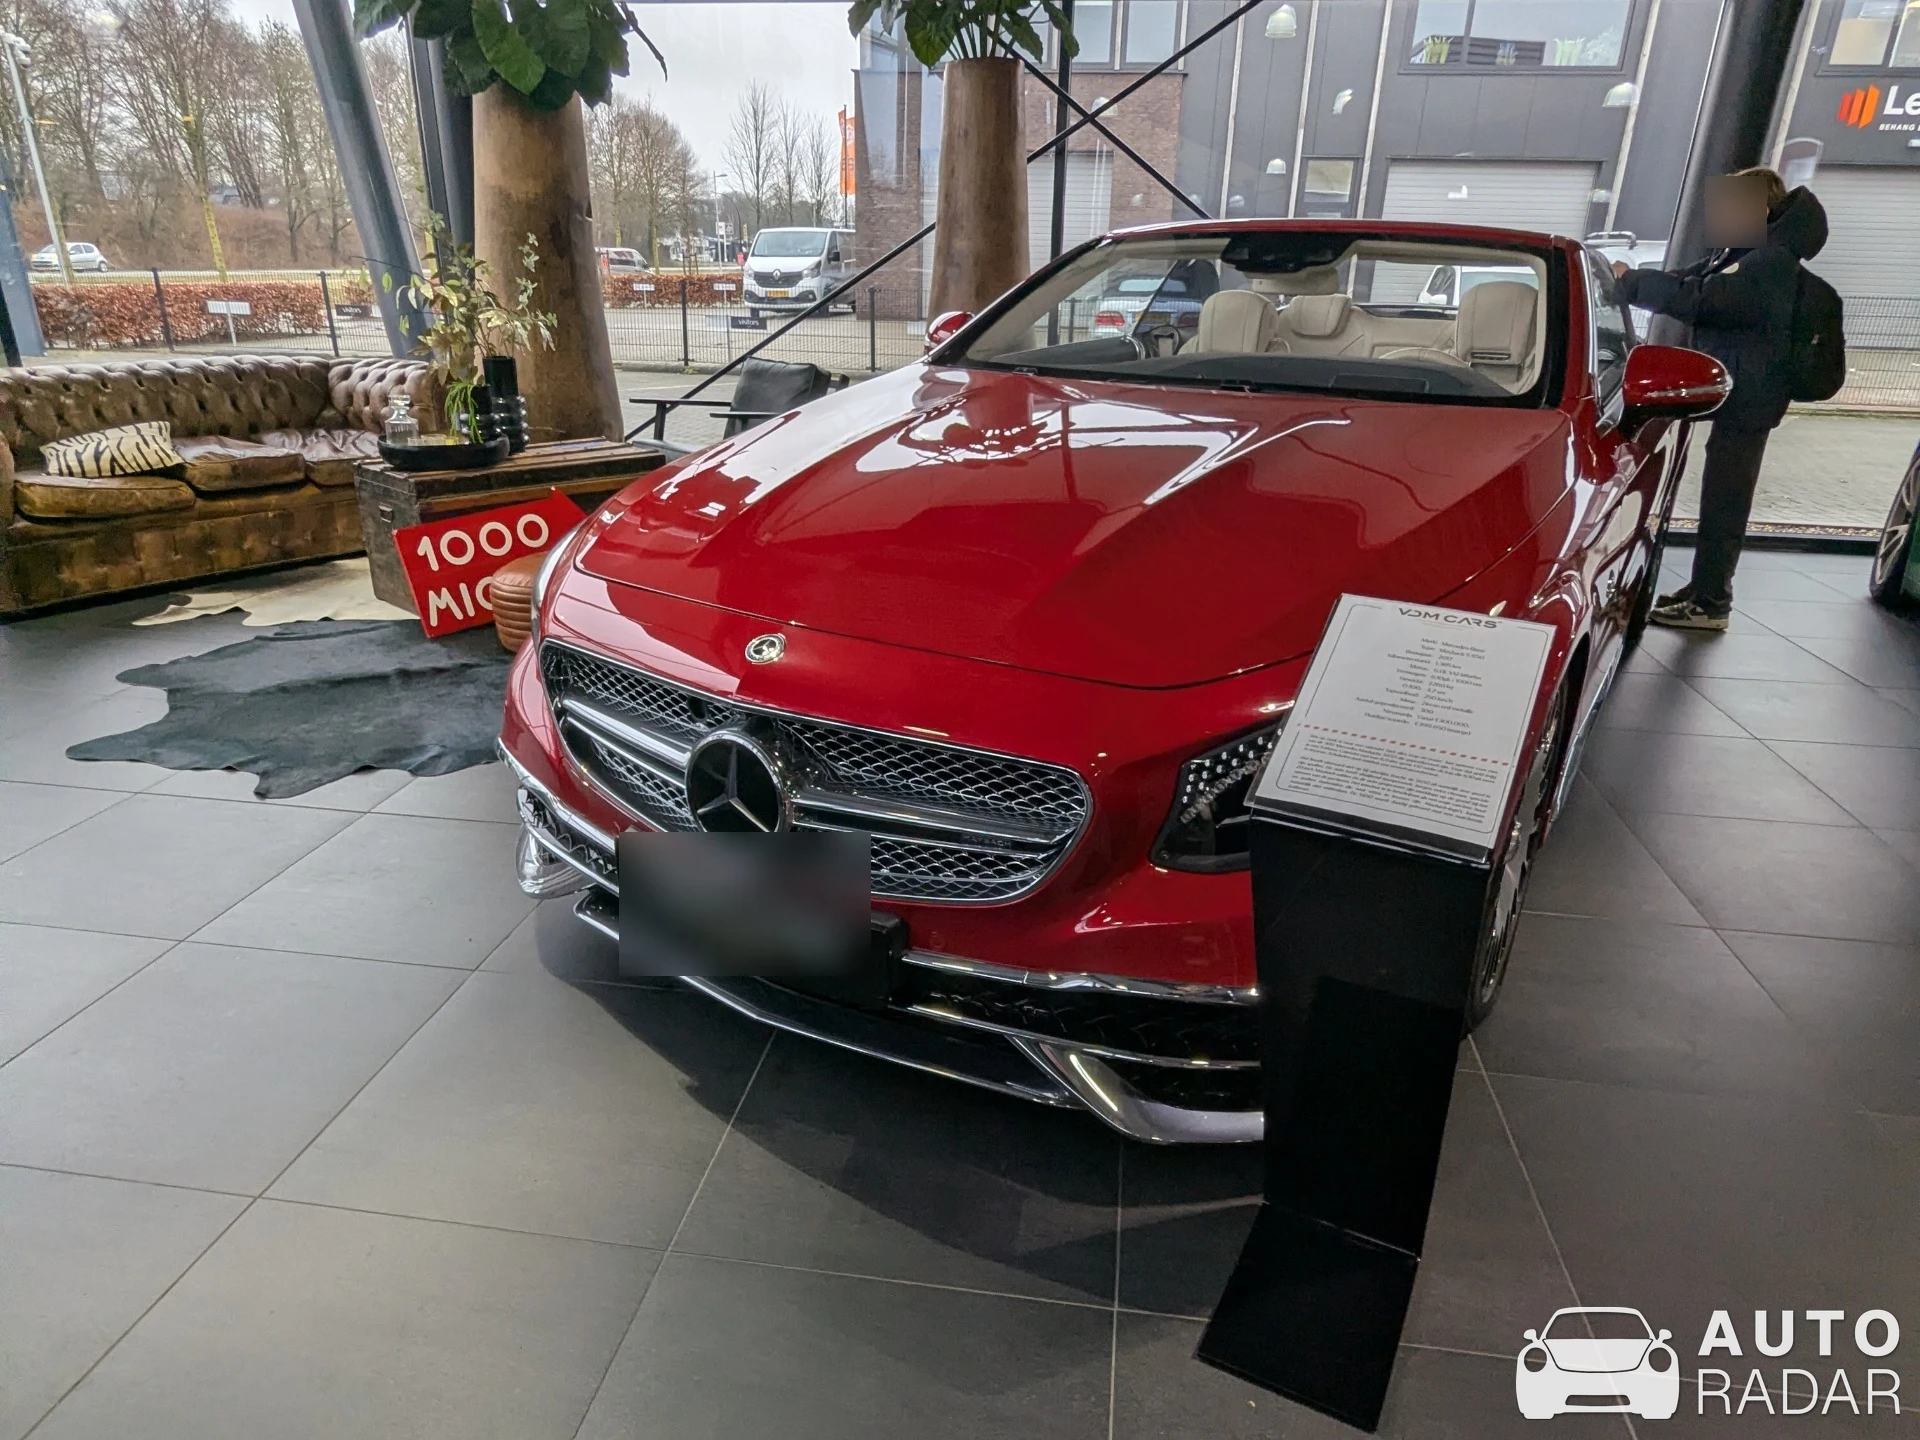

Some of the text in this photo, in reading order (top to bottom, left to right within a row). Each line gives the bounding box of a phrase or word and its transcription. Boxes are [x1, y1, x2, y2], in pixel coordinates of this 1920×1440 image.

[1879, 123, 1916, 131] BEHANG
[417, 513, 549, 572] 1000
[1398, 608, 1498, 629] VDM CARS
